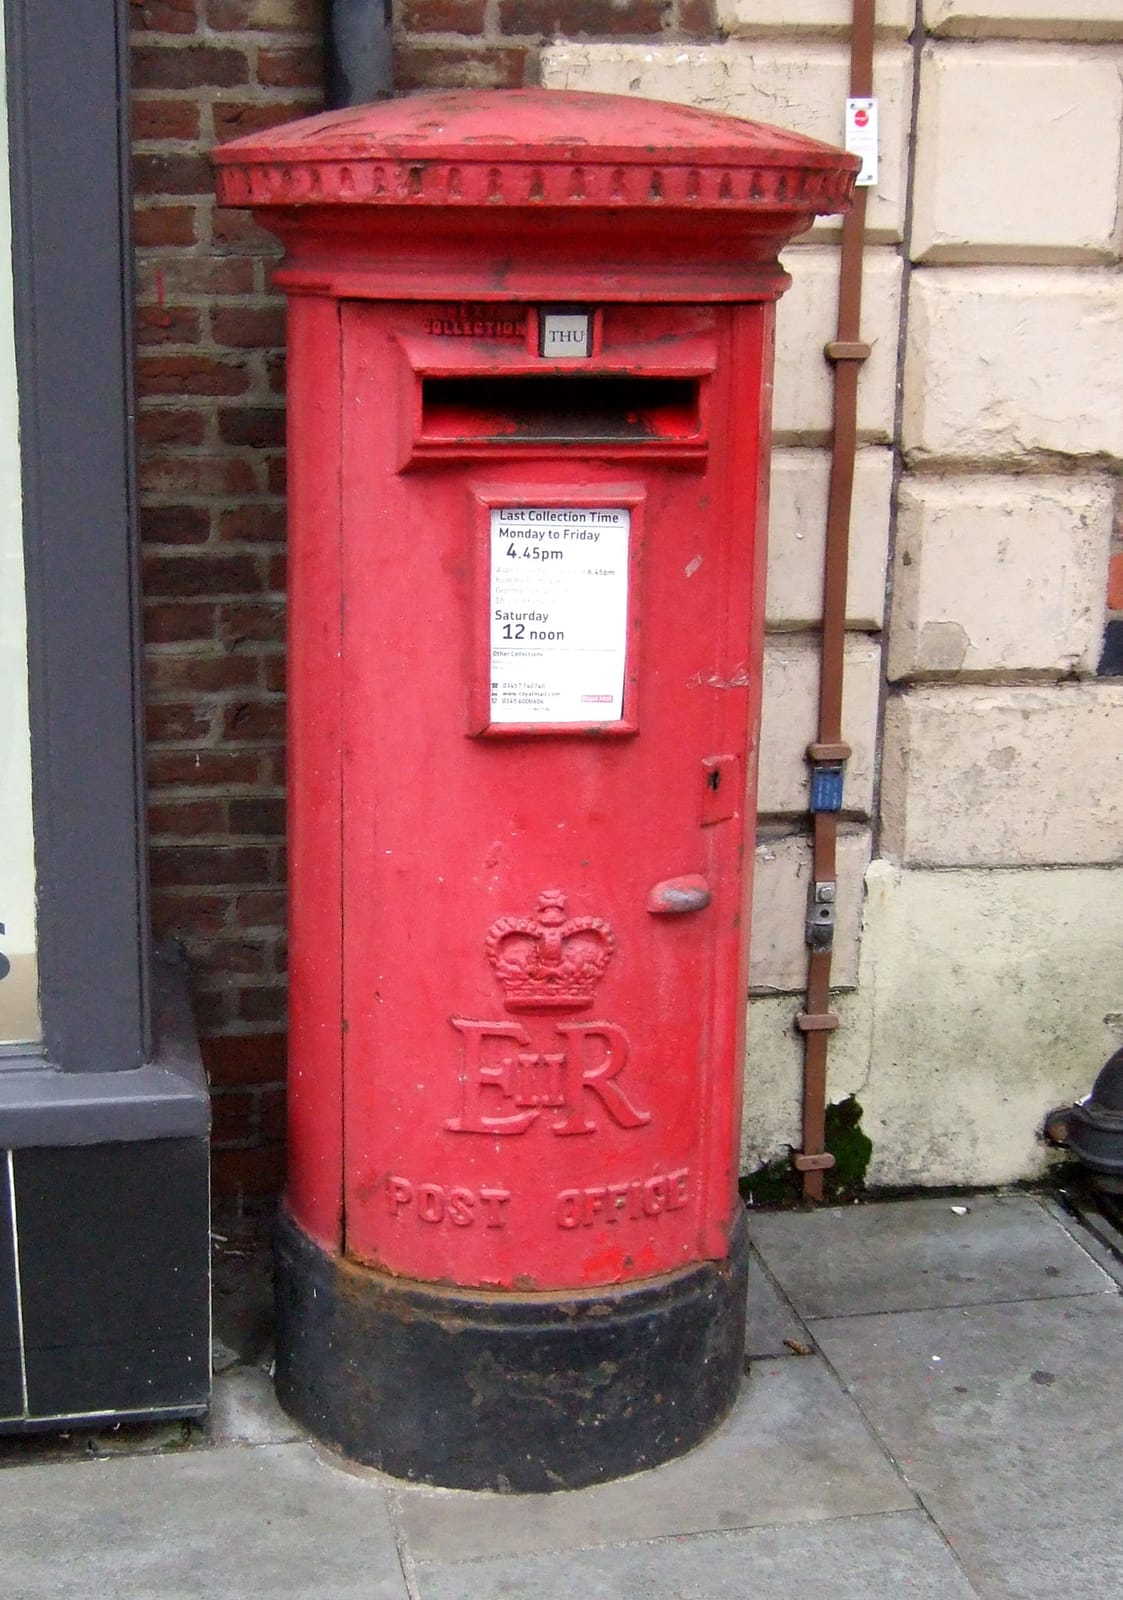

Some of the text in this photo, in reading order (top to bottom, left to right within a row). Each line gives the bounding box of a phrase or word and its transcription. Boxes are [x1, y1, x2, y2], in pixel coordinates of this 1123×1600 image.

[423, 319, 526, 338] COLLECTION
[549, 330, 585, 343] THU
[500, 510, 619, 523] Last Collection Time
[499, 528, 600, 542] Monday to Friday
[506, 542, 563, 562] 4.45pm
[495, 610, 549, 623] Saturday
[502, 623, 564, 640] 12 noon
[385, 1167, 689, 1230] POST OFFICE
